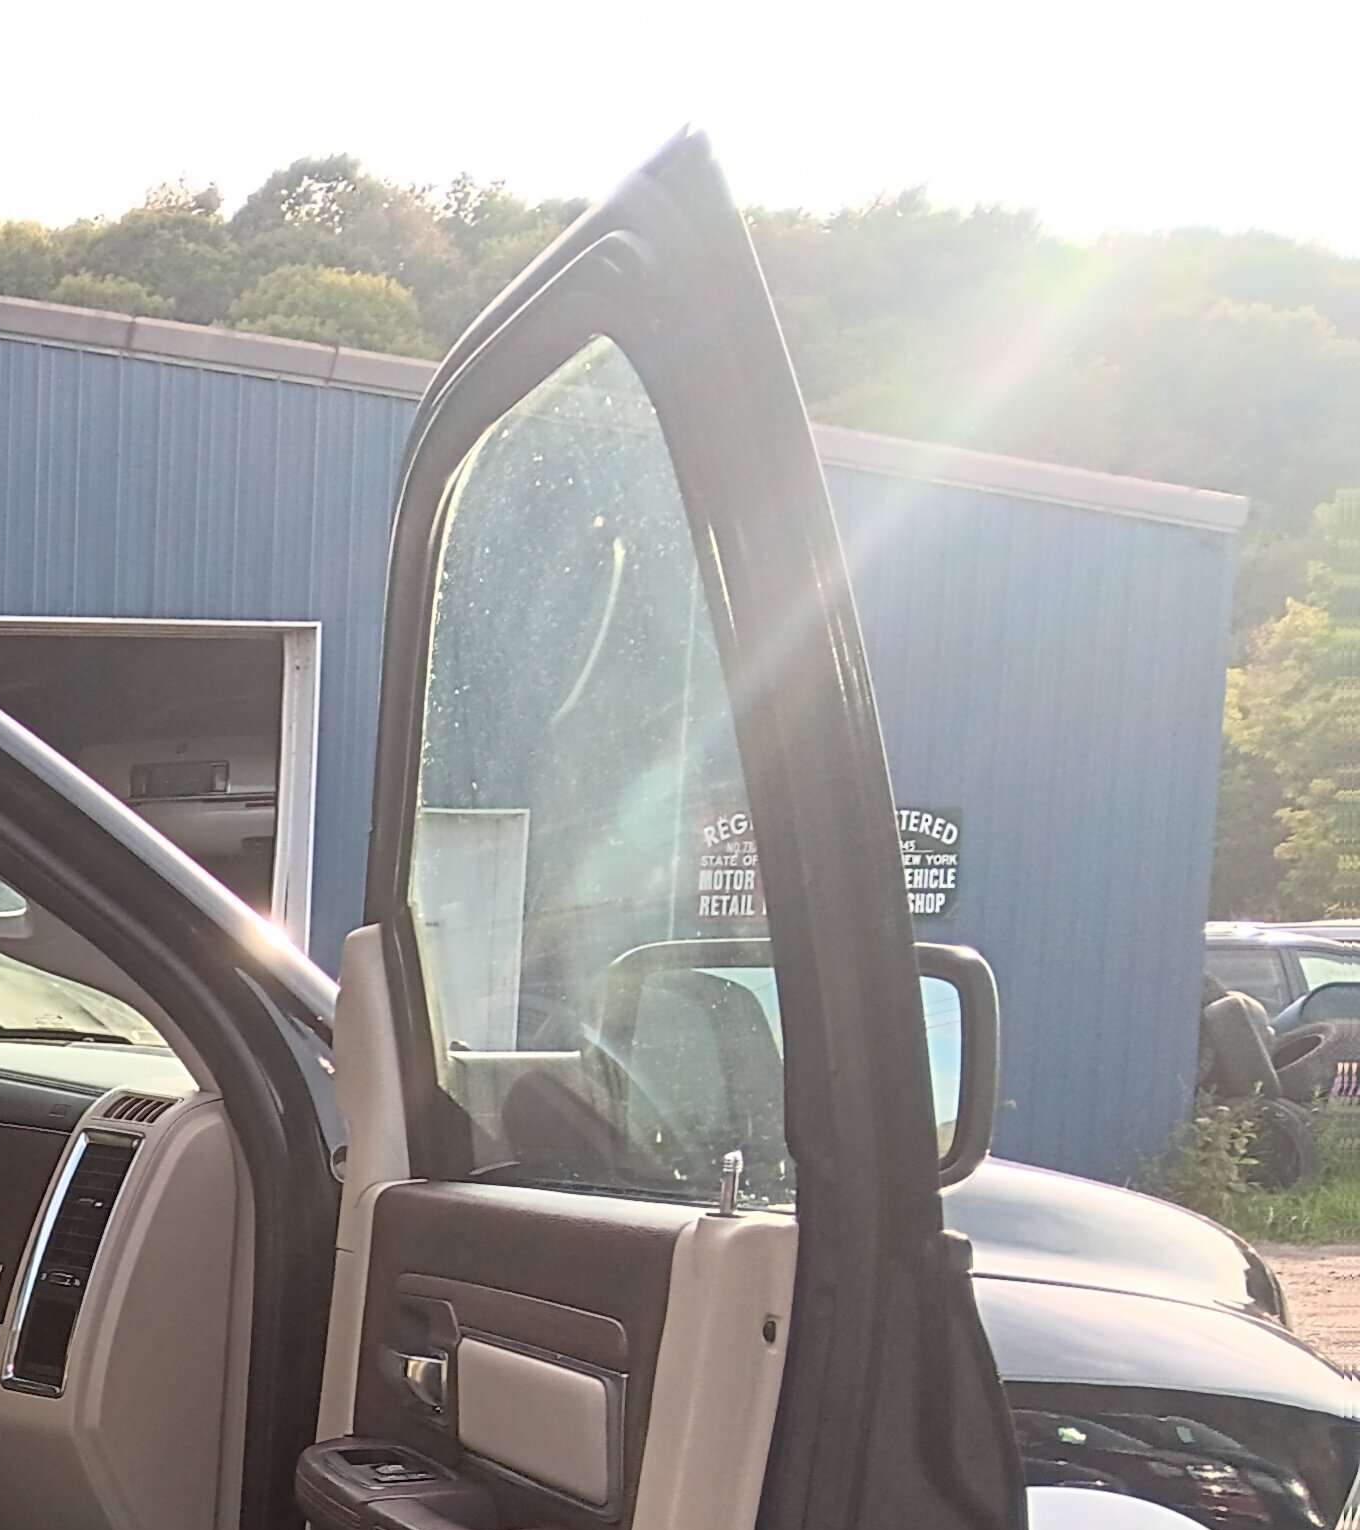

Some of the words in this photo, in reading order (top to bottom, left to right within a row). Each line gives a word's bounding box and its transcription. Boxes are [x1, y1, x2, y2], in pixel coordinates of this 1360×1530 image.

[895, 809, 958, 845] TERED
[700, 855, 738, 867] STATE
[925, 854, 958, 866] YORK
[699, 869, 755, 891] MOTOR
[699, 894, 755, 917] RETAIL
